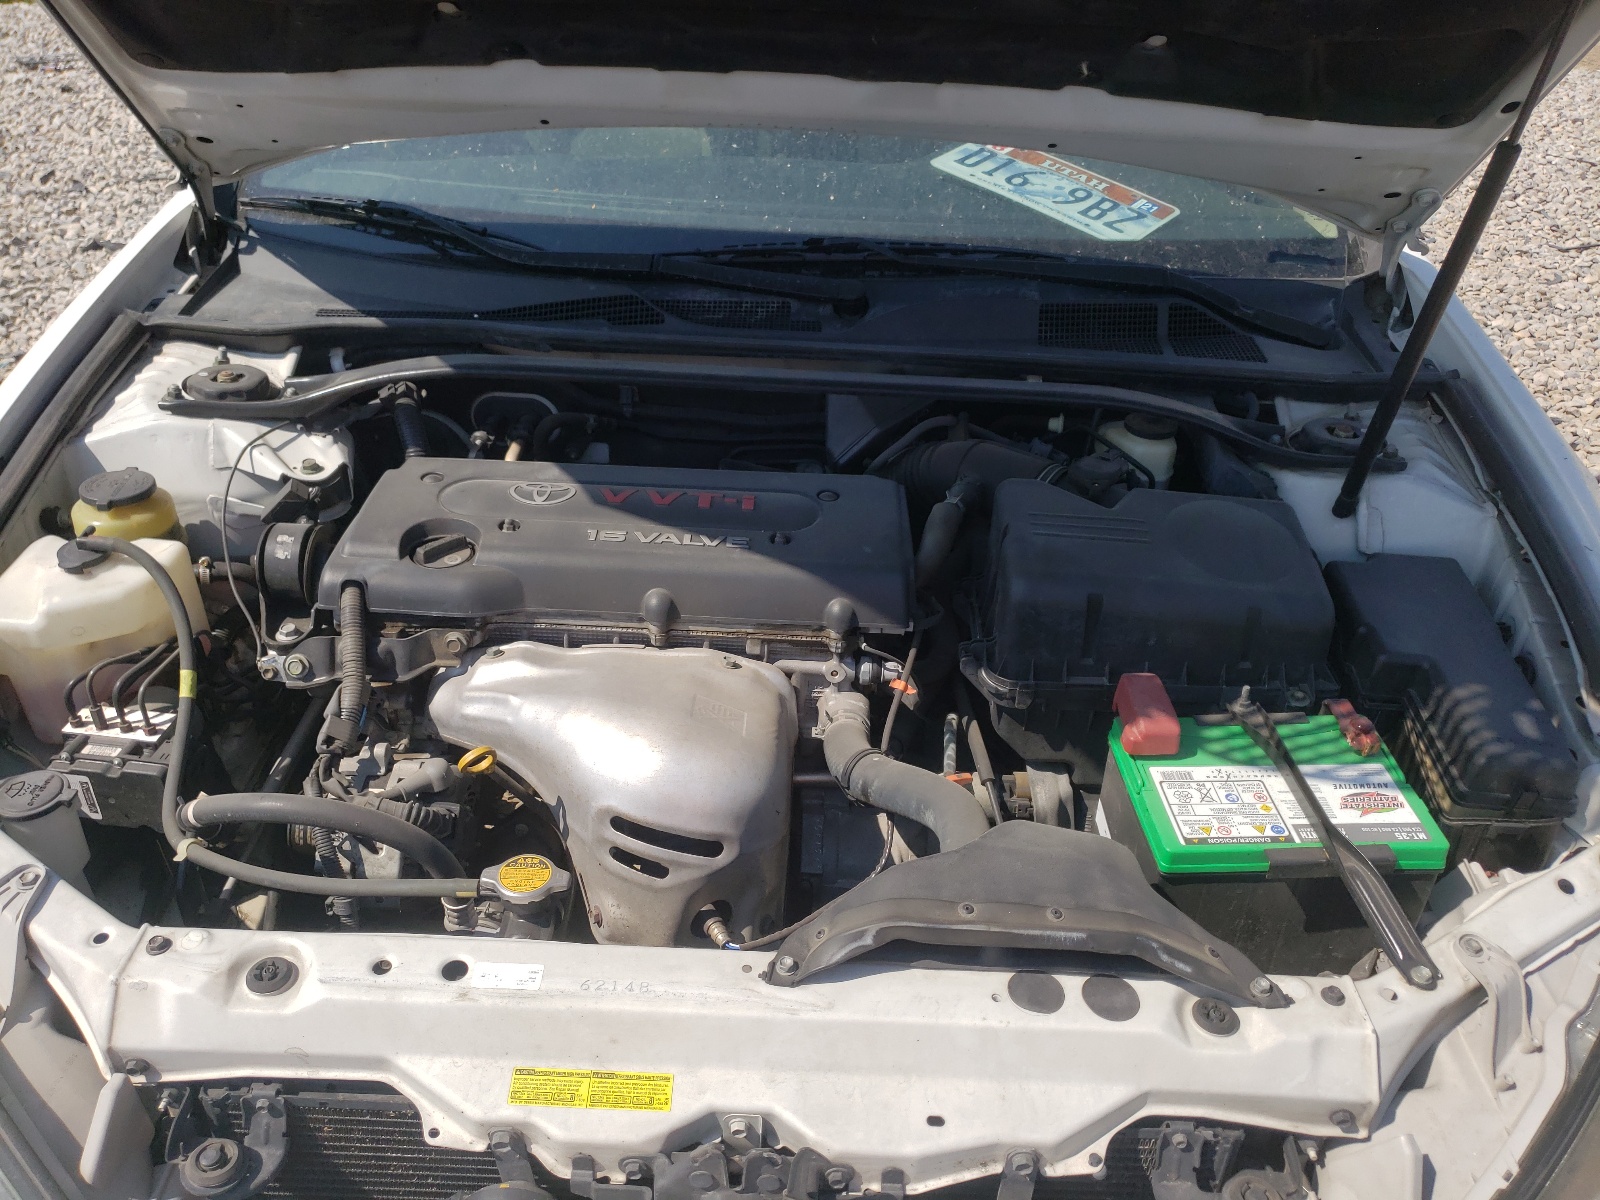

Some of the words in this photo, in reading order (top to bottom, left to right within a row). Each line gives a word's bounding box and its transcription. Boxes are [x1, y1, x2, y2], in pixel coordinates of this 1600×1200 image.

[1039, 159, 1109, 191] UTAH
[1051, 187, 1149, 234] 9BZ
[1142, 202, 1160, 213] 21
[633, 531, 751, 549] VALVE
[1333, 782, 1389, 790] AUTOMOTIVE
[1341, 802, 1404, 810] INTERSTATE
[1207, 836, 1271, 844] DANGER/POISON
[1394, 832, 1428, 841] MT-35
